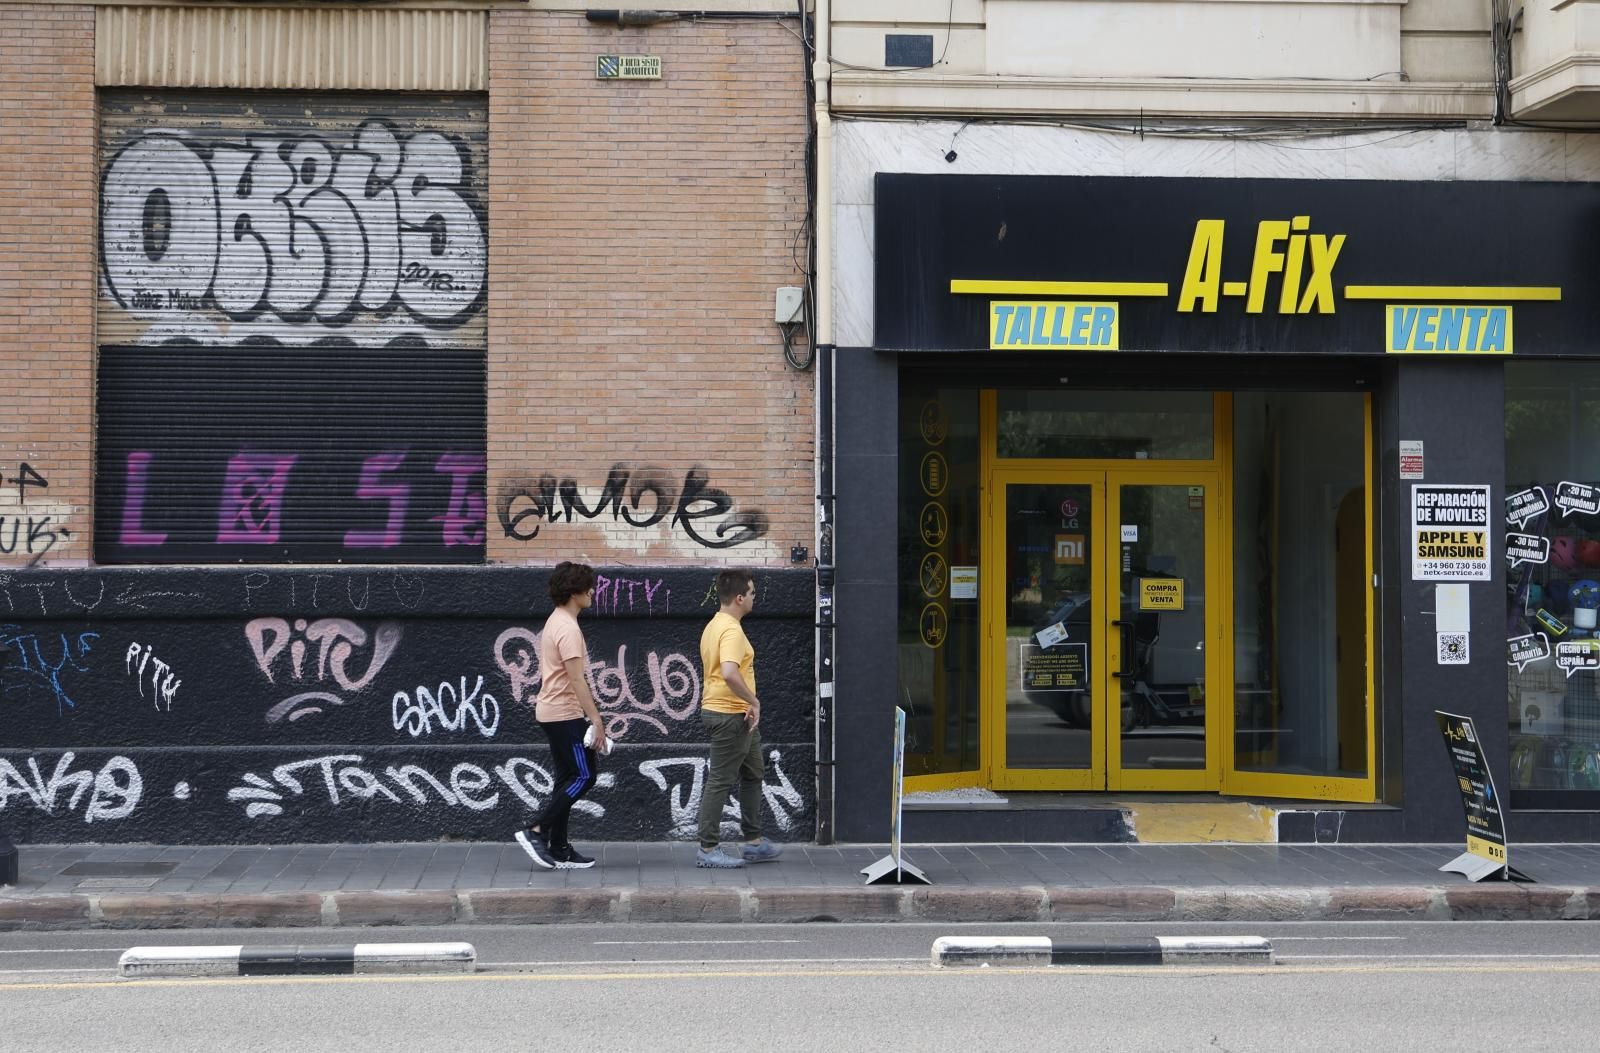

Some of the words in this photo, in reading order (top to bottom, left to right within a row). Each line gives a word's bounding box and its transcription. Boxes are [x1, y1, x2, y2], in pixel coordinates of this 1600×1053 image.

[1177, 216, 1347, 314] A-Fix
[993, 305, 1117, 346] TALLER
[1391, 307, 1508, 352] VENTA
[1416, 490, 1486, 507] REPARACIÓN
[1416, 508, 1432, 521] DE
[1434, 508, 1486, 522] MOVILES
[1418, 531, 1469, 544] APPLE
[1473, 532, 1484, 544] Y
[1418, 545, 1484, 558] SAMSUNG
[1423, 562, 1438, 570] +34
[1439, 562, 1454, 570] 960
[1455, 562, 1471, 570] 730
[1146, 584, 1178, 592] COMPRA
[1560, 645, 1581, 654] HECHO
[1582, 645, 1591, 654] EN
[1560, 655, 1585, 666] ESPAÑA
